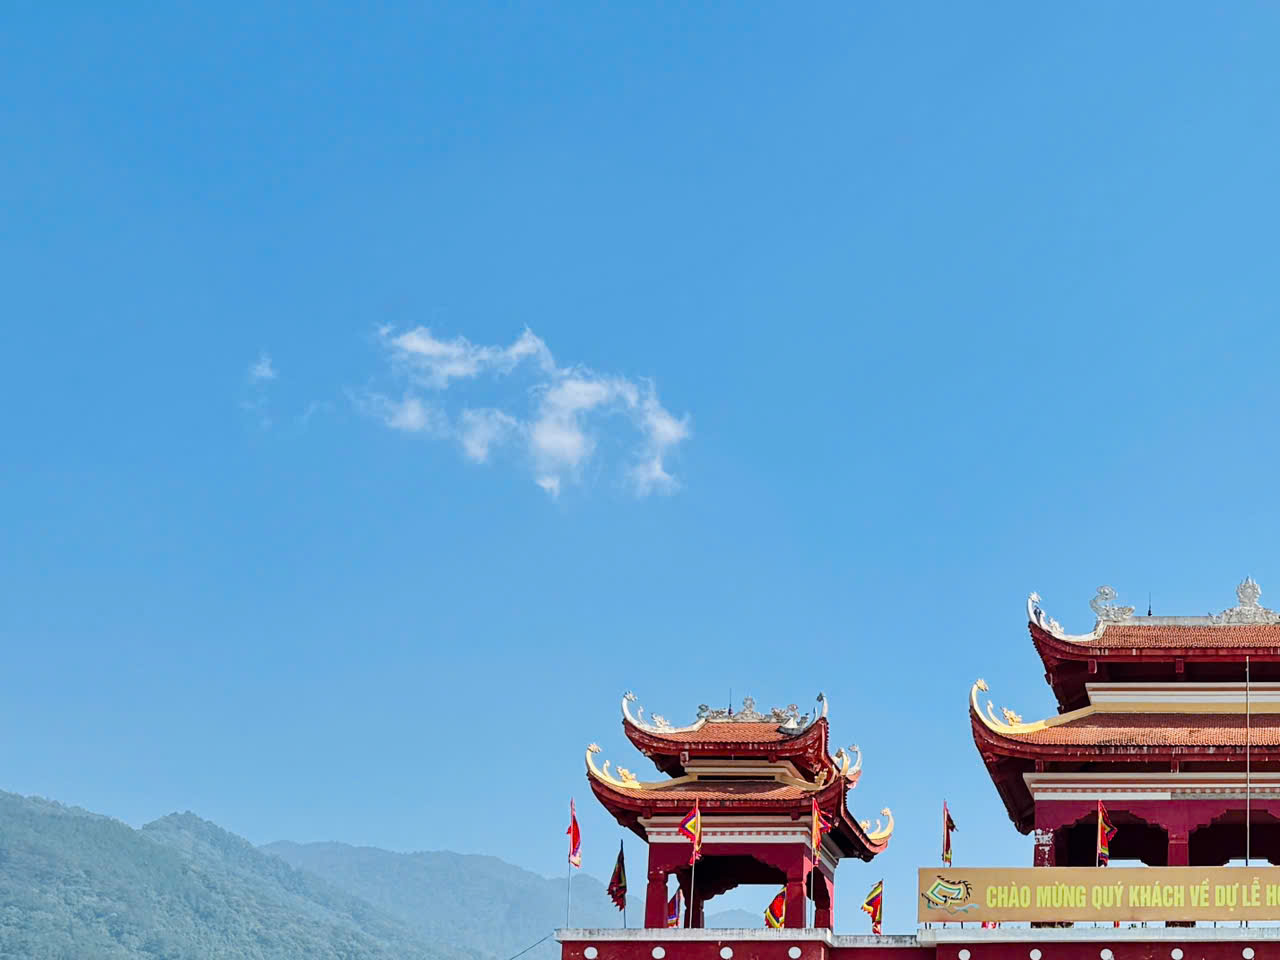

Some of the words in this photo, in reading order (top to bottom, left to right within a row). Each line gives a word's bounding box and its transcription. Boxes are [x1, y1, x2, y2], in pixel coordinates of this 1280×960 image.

[986, 881, 1031, 908] CHÀO
[1036, 881, 1087, 908] MỪNG
[1092, 881, 1124, 911] QUÝ
[1129, 881, 1185, 908] KHÁCH
[1215, 882, 1239, 912] DỰ
[1242, 877, 1261, 907] LỄ
